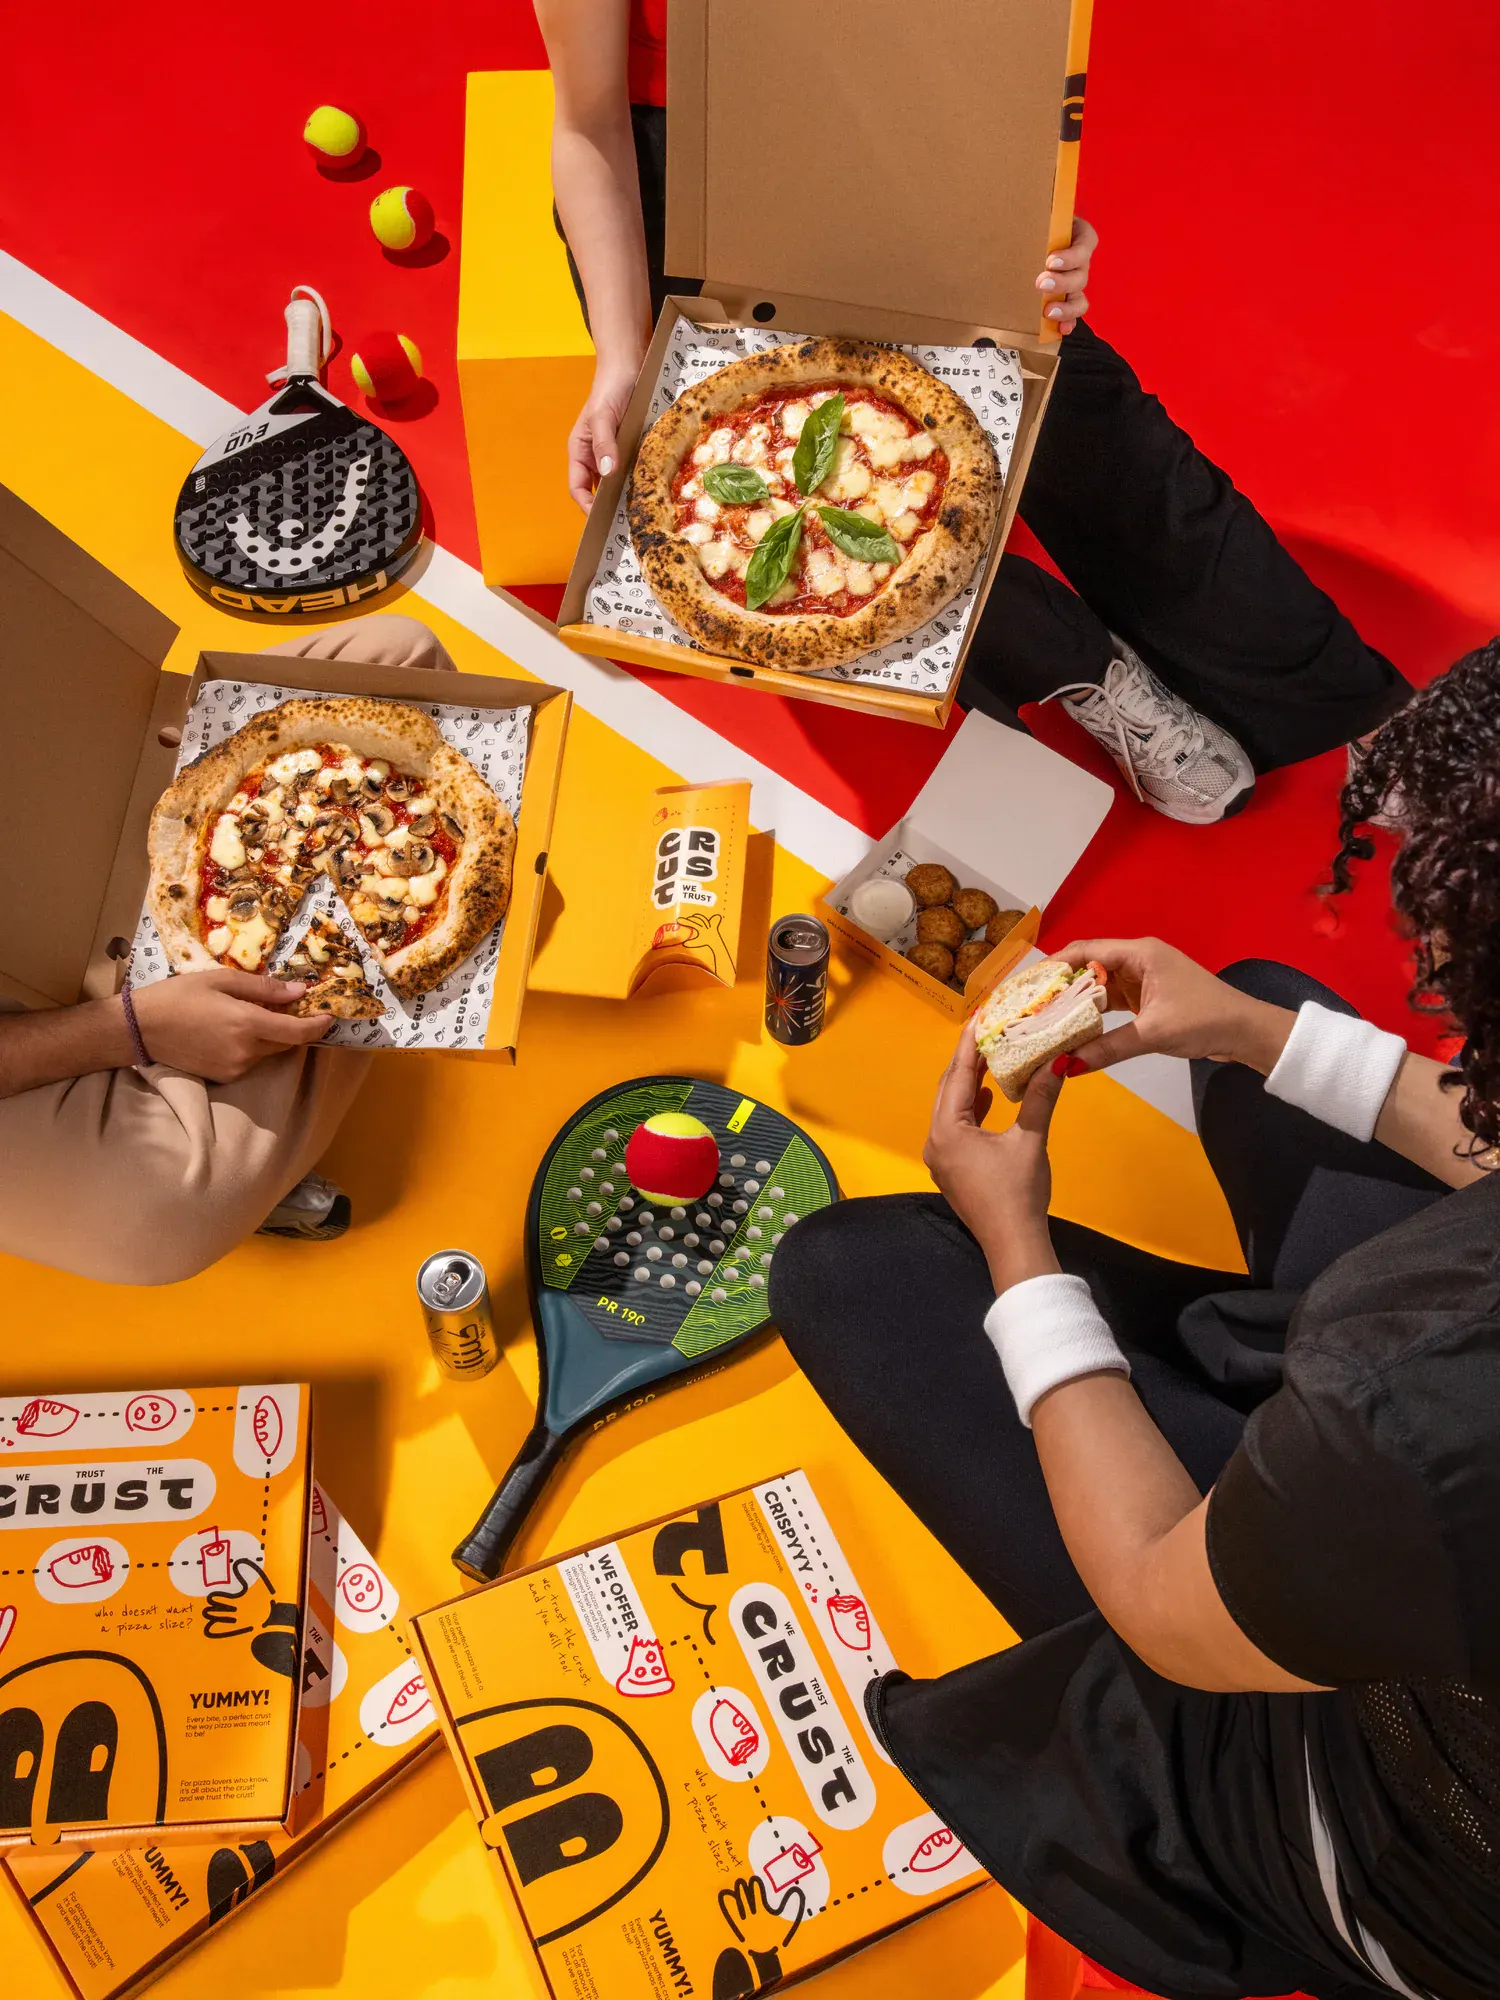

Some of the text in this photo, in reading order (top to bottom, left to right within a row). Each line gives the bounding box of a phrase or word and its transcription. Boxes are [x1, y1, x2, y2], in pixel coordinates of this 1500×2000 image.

[932, 366, 980, 378] CRUST
[223, 423, 270, 455] EVO
[211, 572, 388, 614] HEAD
[614, 602, 663, 620] CRUST
[852, 668, 903, 681] CRUST
[682, 884, 697, 892] WE
[683, 892, 712, 902] TRUST
[410, 994, 426, 1031] CRUS
[454, 988, 470, 1034] CRUST
[597, 1296, 645, 1326] PR 190
[593, 1412, 617, 1431] PR
[16, 1466, 164, 1481] WE TRUST THE
[764, 1491, 814, 1572] CRISPYYY
[598, 1553, 639, 1632] WE OFFER
[94, 1602, 194, 1618] who doesn't want
[550, 1594, 568, 1623] trust
[564, 1628, 576, 1649] the
[116, 1622, 152, 1636] pizza
[159, 1617, 193, 1630] slize?
[308, 1626, 324, 1644] THE
[528, 1583, 572, 1674] and you will too!
[190, 1689, 270, 1709] YUMMY!
[742, 1600, 857, 1812] CRUST
[784, 1621, 855, 1765] WE TRUST THE
[186, 1716, 205, 1724] Every
[228, 1714, 253, 1722] perfect
[194, 1730, 205, 1738] be!
[192, 1780, 211, 1788] pizza
[200, 1786, 222, 1794] about
[684, 1782, 730, 1873] a pizza slize?
[694, 1768, 743, 1867] who doesn't want
[139, 1846, 190, 1911] UMMY!
[123, 1864, 134, 1879] way
[131, 1878, 144, 1895] pizza
[142, 1894, 152, 1908] was
[149, 1907, 164, 1928] meant
[144, 1885, 162, 1908] perfect
[158, 1907, 171, 1924] crust
[74, 1902, 87, 1920] pizza
[56, 1902, 67, 1916] and
[64, 1915, 72, 1926] we
[69, 1924, 83, 1941] trust
[78, 1939, 86, 1952] the
[72, 1914, 87, 1936] about
[83, 1933, 92, 1945] the
[621, 1924, 634, 1944] to be!
[634, 1917, 646, 1937] Every
[628, 1920, 656, 1986] the way pizza was
[638, 1937, 652, 1955] bite,
[649, 1908, 694, 1998] YUMMY!
[562, 1950, 582, 1997] and we trust
[573, 1970, 589, 1992] about
[646, 1962, 666, 1989] perfect
